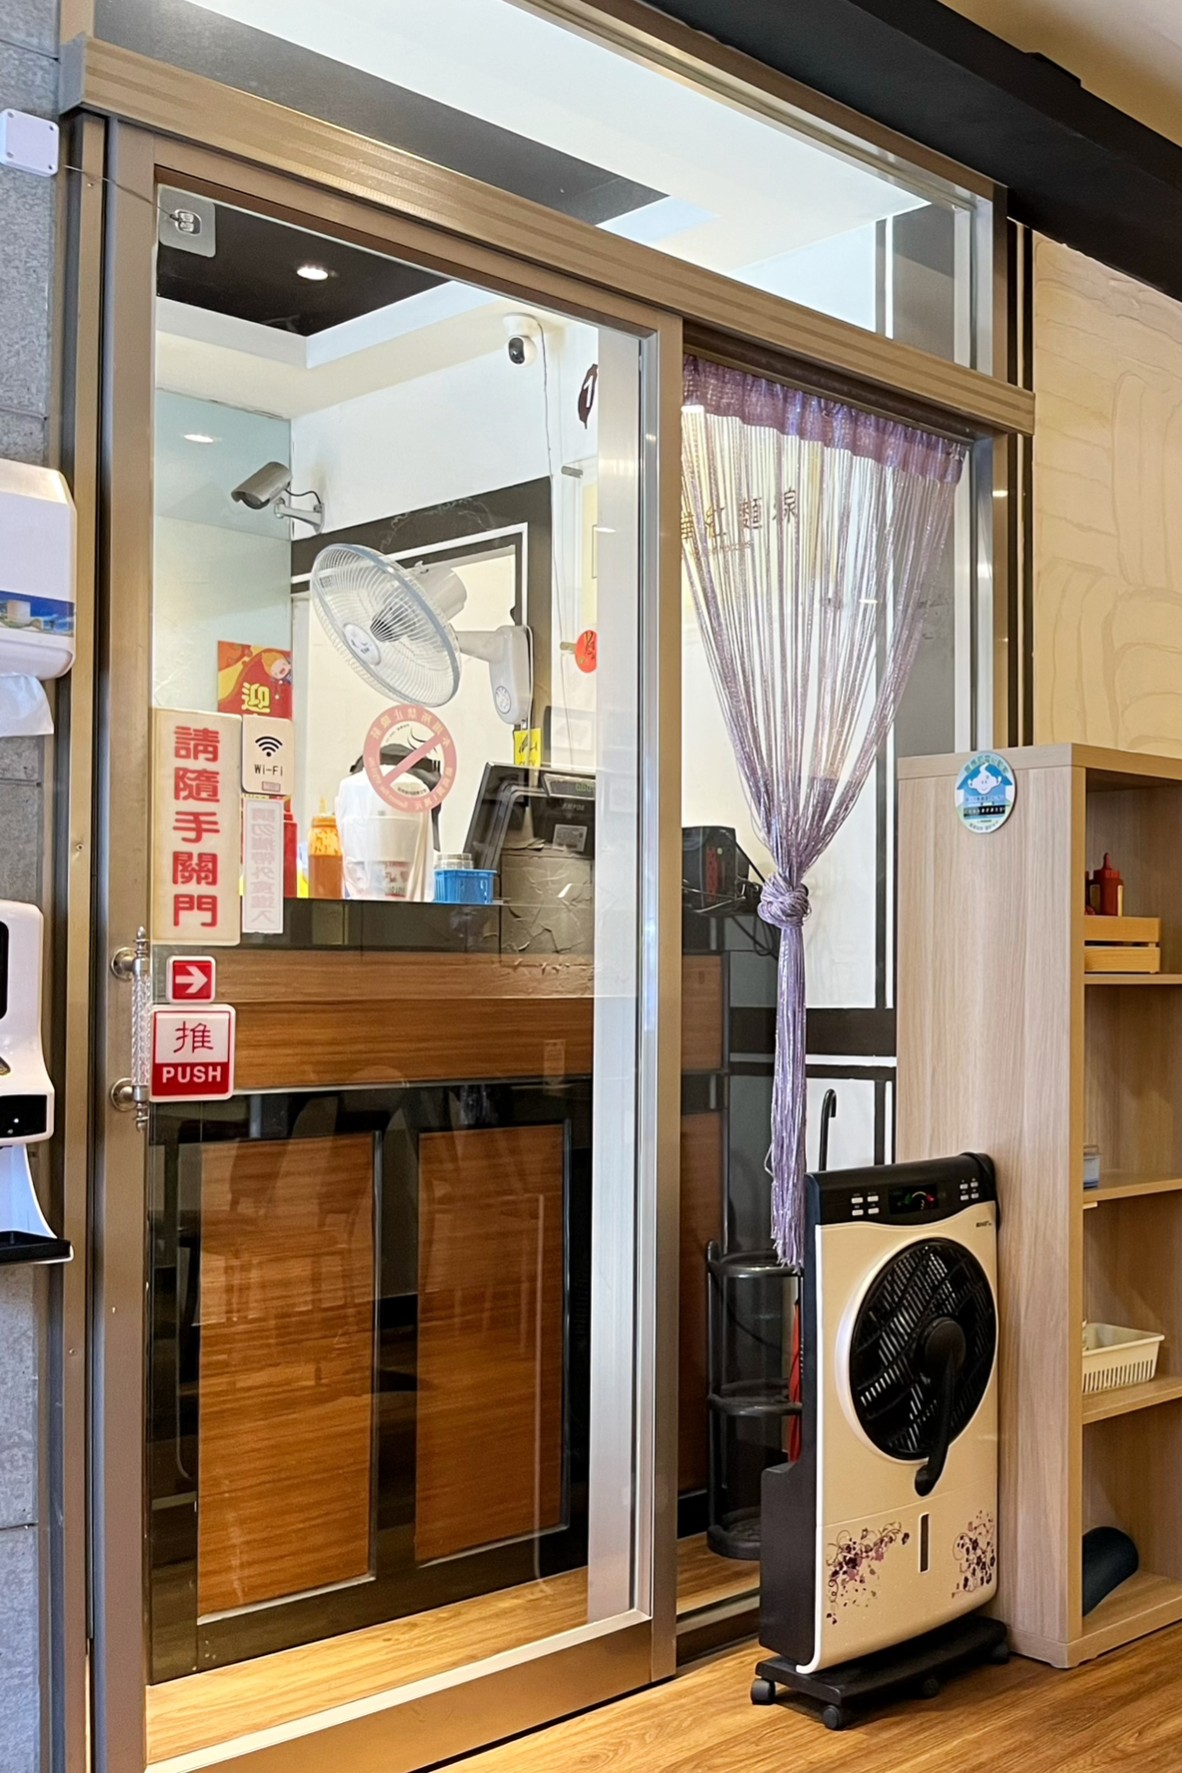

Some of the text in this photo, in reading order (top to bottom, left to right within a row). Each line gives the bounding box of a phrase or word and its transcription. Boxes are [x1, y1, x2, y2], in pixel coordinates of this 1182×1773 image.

[241, 682, 271, 713] 迎
[254, 763, 283, 776] Wi-Fi
[172, 726, 220, 927] 請隨手關門
[173, 1020, 214, 1054] 推
[162, 1065, 222, 1084] PUSH
